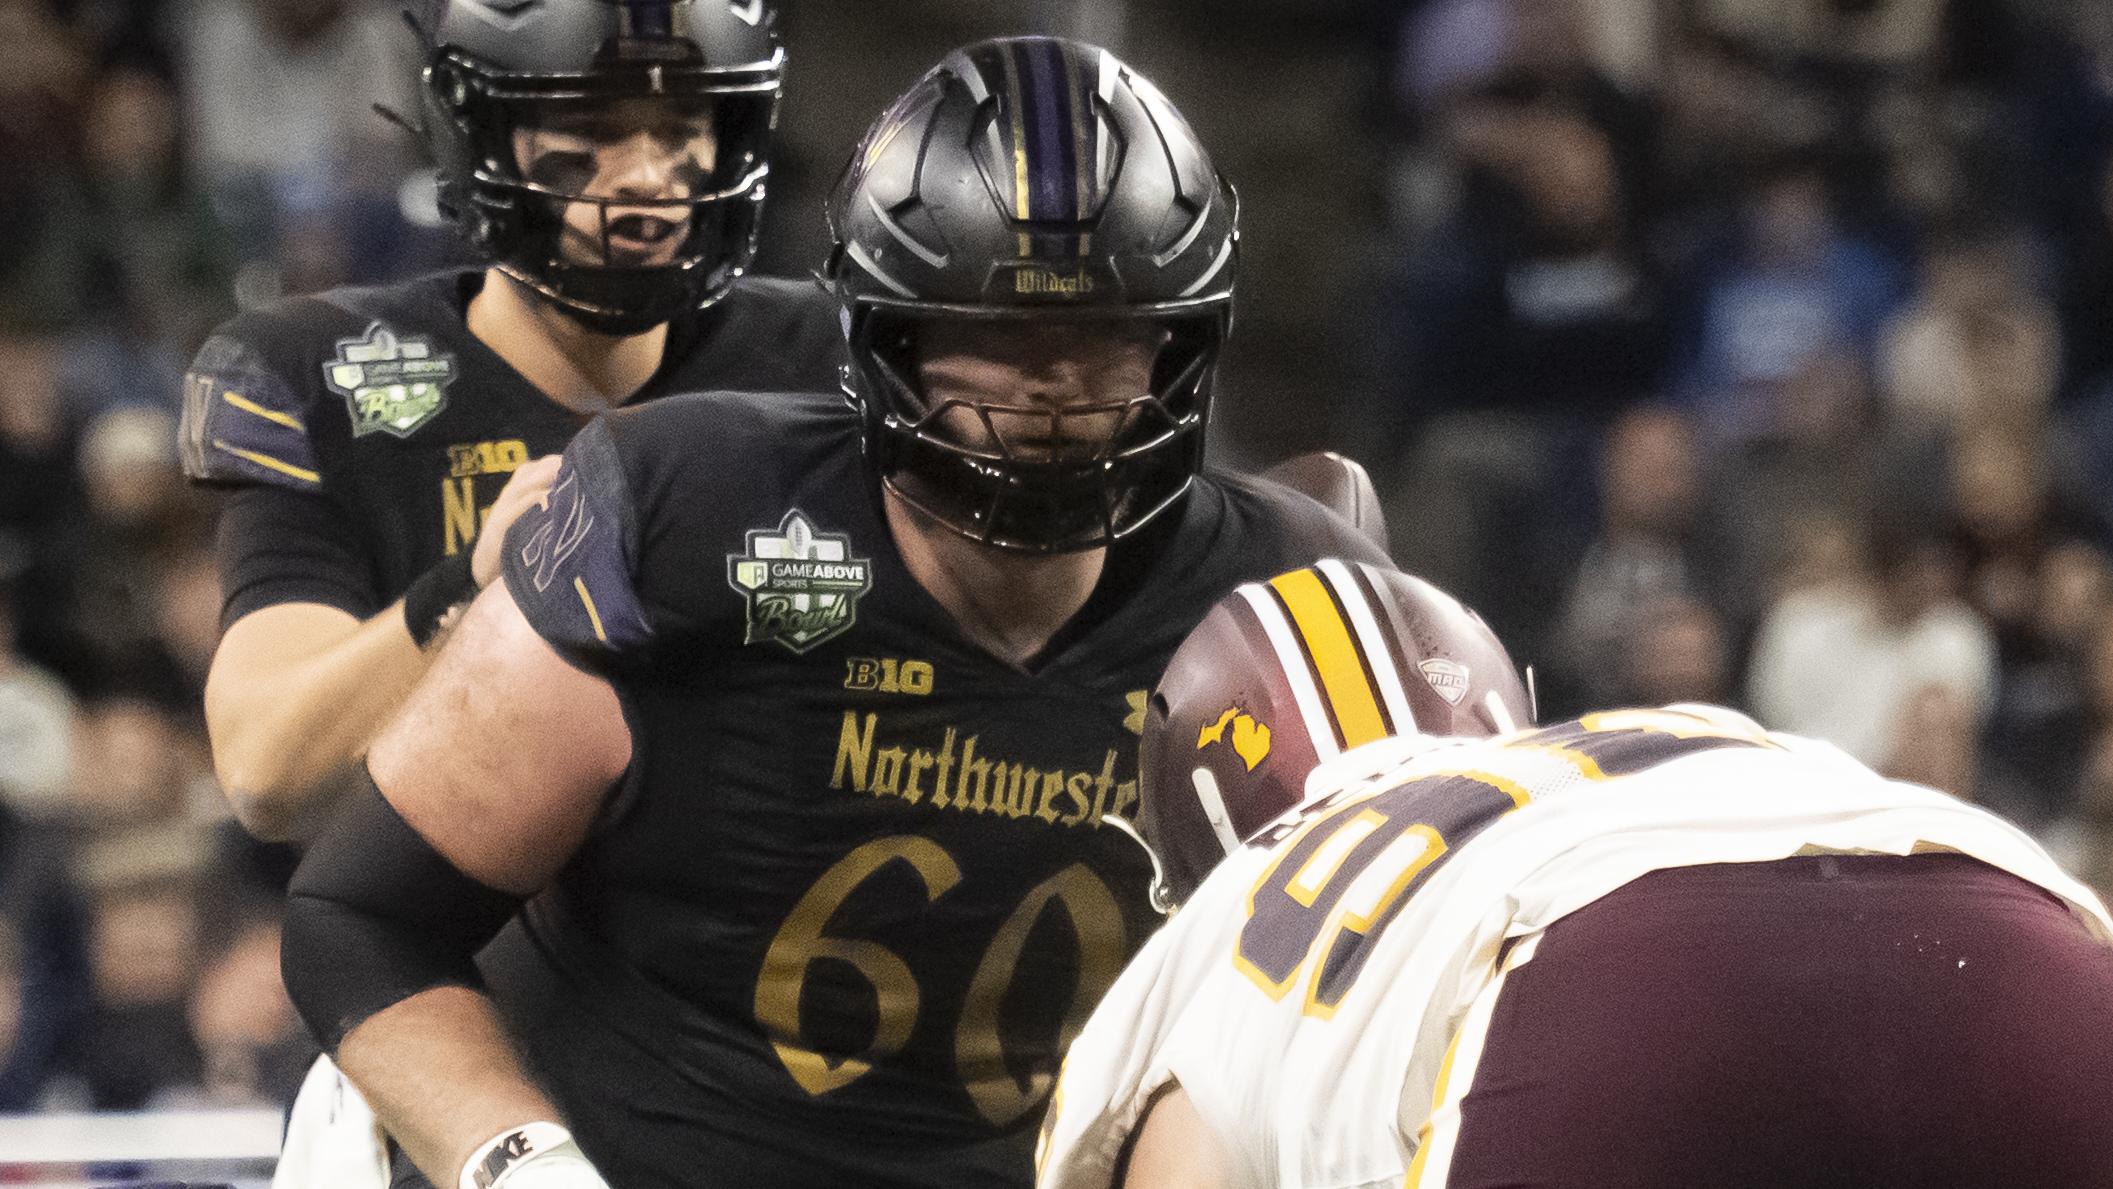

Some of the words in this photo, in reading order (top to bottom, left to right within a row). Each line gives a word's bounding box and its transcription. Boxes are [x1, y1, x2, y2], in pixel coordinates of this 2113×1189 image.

[773, 579, 809, 589] SPORTS
[757, 594, 847, 633] Bowl
[754, 834, 1128, 1128] 60
[473, 1131, 534, 1189] NIKE
